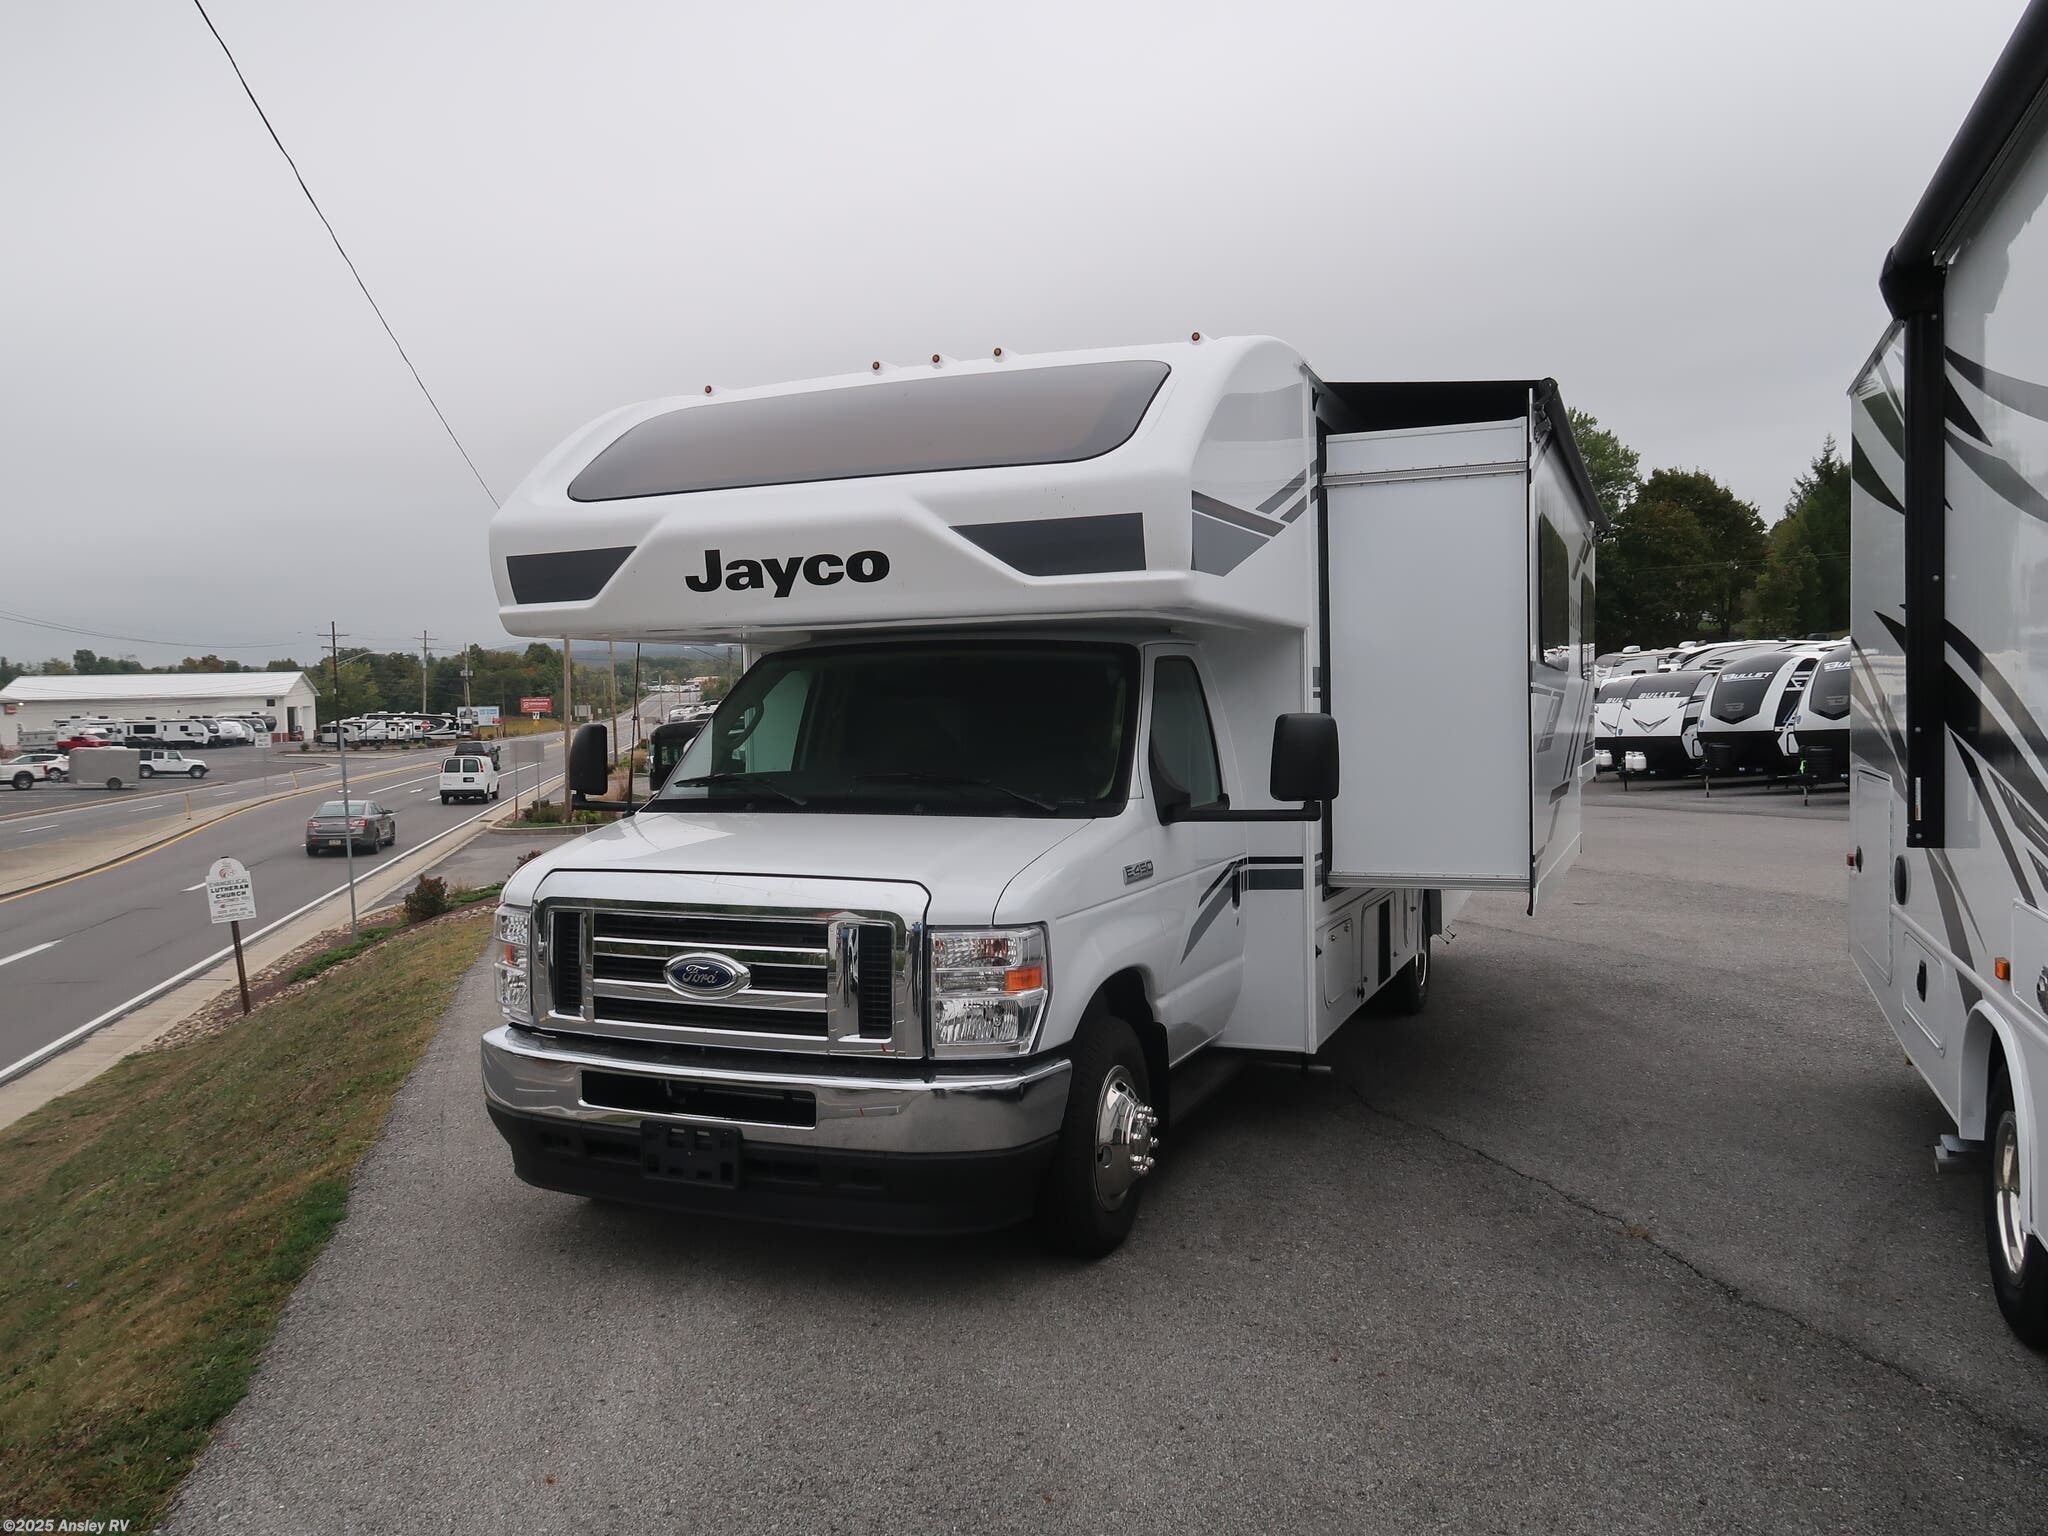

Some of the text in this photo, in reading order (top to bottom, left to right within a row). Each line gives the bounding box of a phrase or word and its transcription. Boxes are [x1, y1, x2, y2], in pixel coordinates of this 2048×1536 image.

[685, 550, 890, 598] Jayco
[1722, 671, 1773, 682] BULLET
[1638, 691, 1681, 699] BULLET
[210, 884, 249, 894] LUTHERAN
[215, 890, 247, 899] CHURCH
[682, 964, 719, 984] Ford
